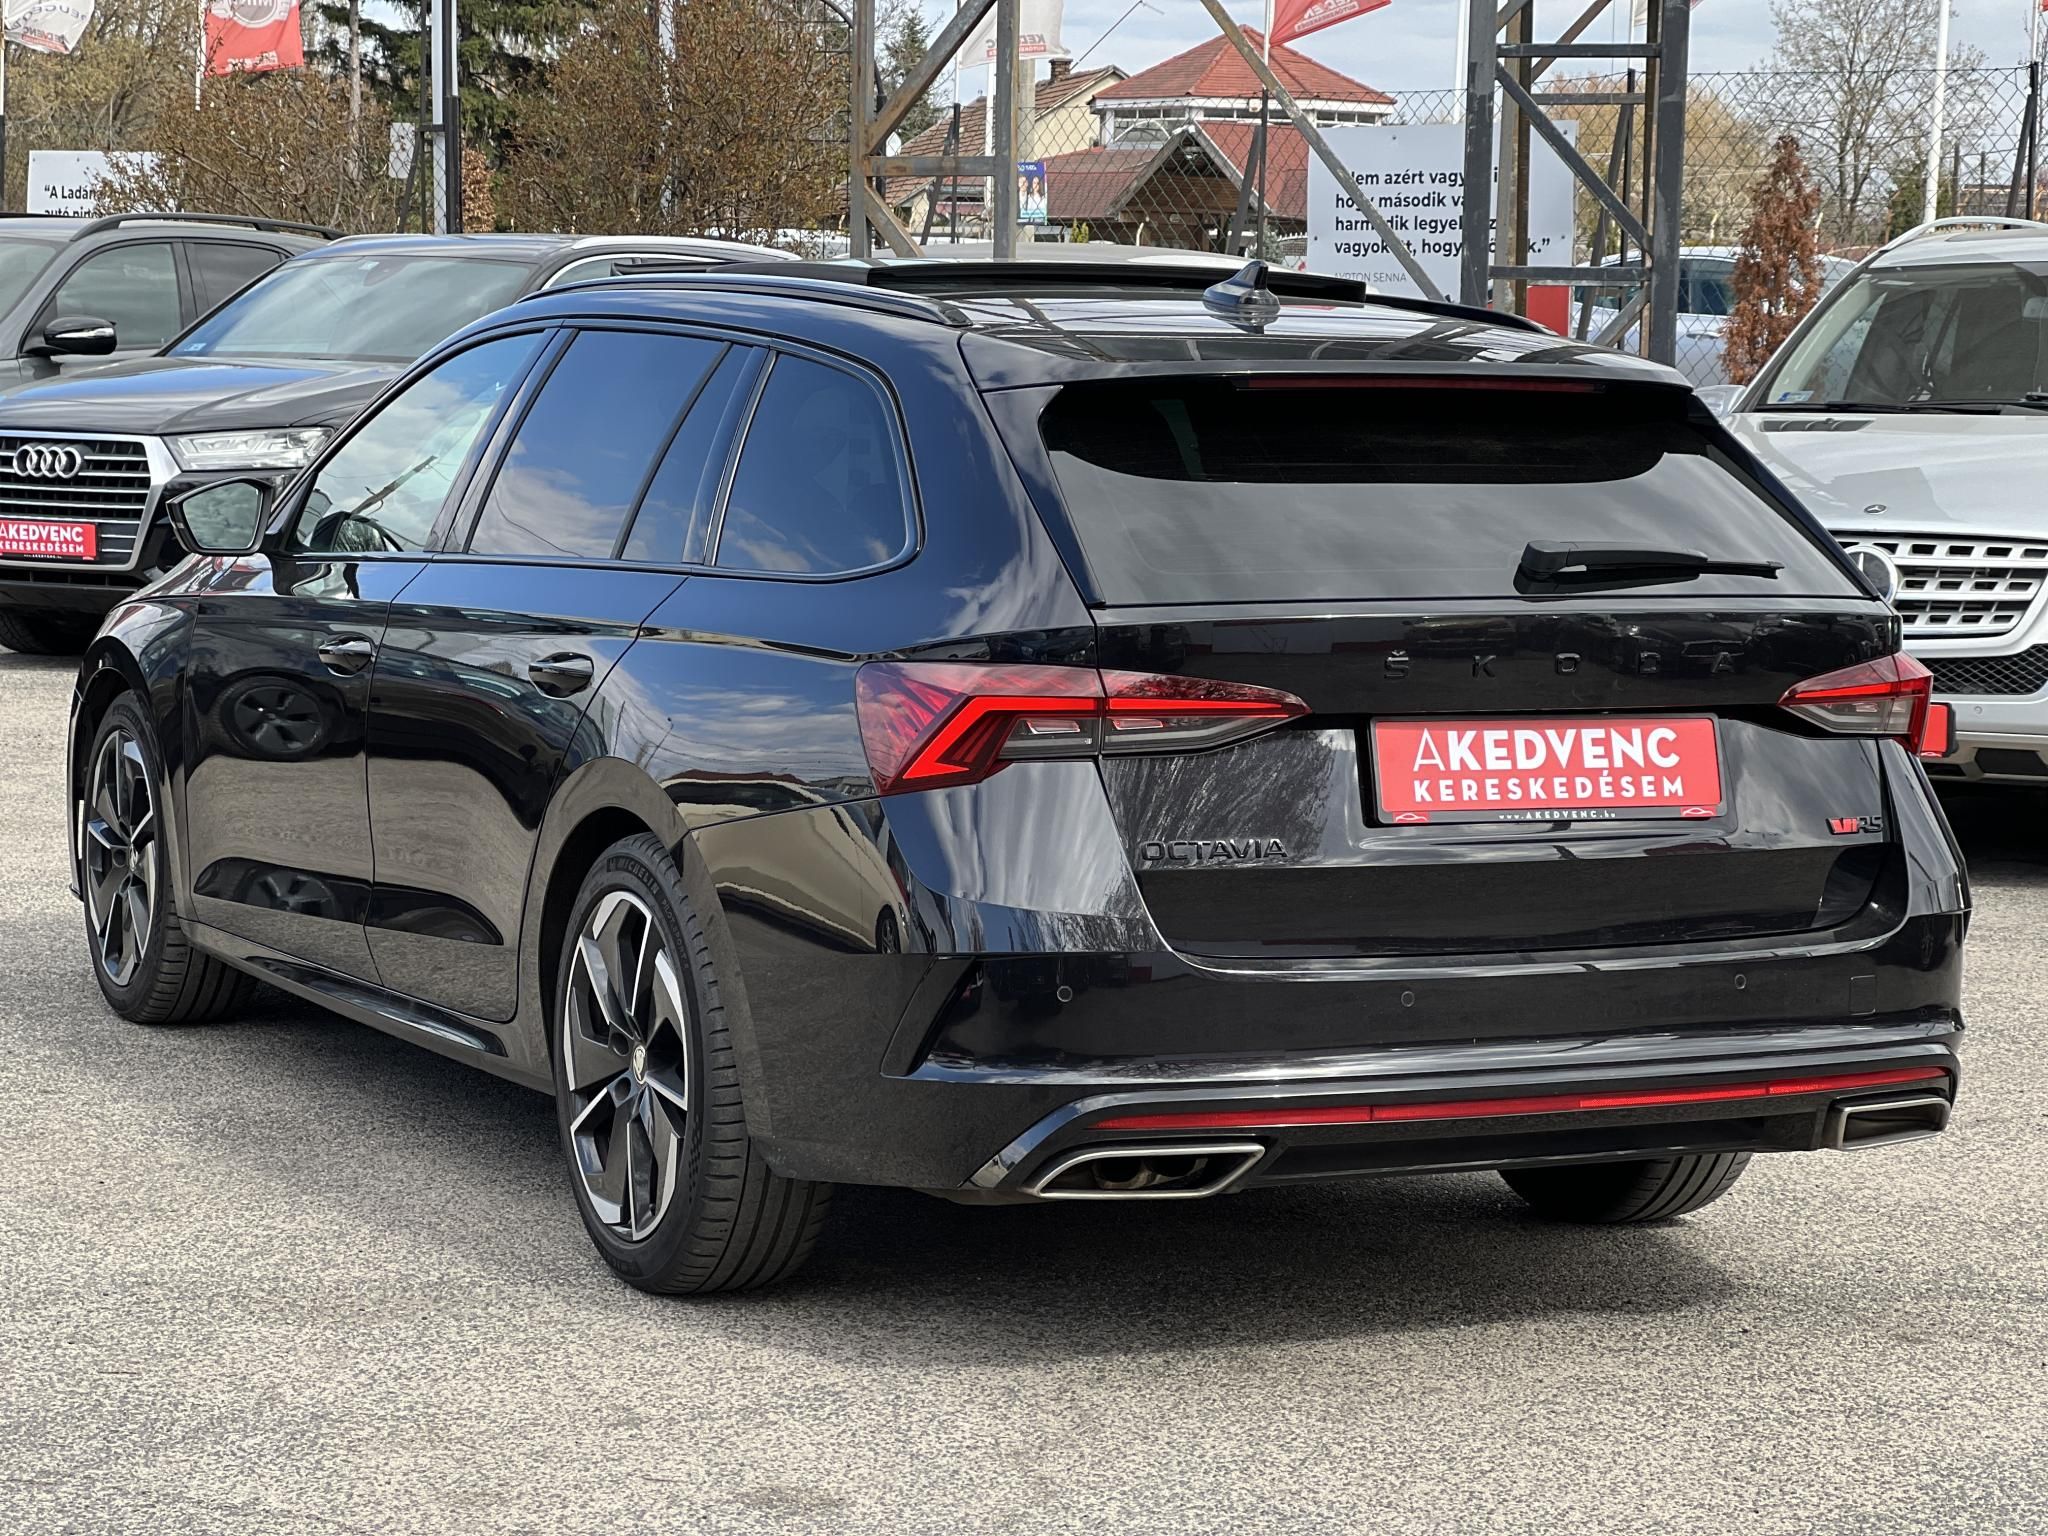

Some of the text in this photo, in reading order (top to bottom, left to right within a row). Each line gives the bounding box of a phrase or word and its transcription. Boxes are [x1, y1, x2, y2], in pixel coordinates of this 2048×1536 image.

[1352, 169, 1464, 187] em azért vagy
[1378, 192, 1446, 208] második
[1335, 215, 1409, 231] harmdik
[1335, 238, 1390, 257] vagyok
[1421, 239, 1463, 257] hogy
[1373, 272, 1407, 282] SENNA
[0, 522, 84, 543] AKEDVENC
[1412, 727, 1681, 773] AKEDVENC
[1413, 770, 1684, 802] KERESKEDÉSEM
[1139, 838, 1288, 861] OCTAVIA
[616, 857, 660, 895] MICHELIN
